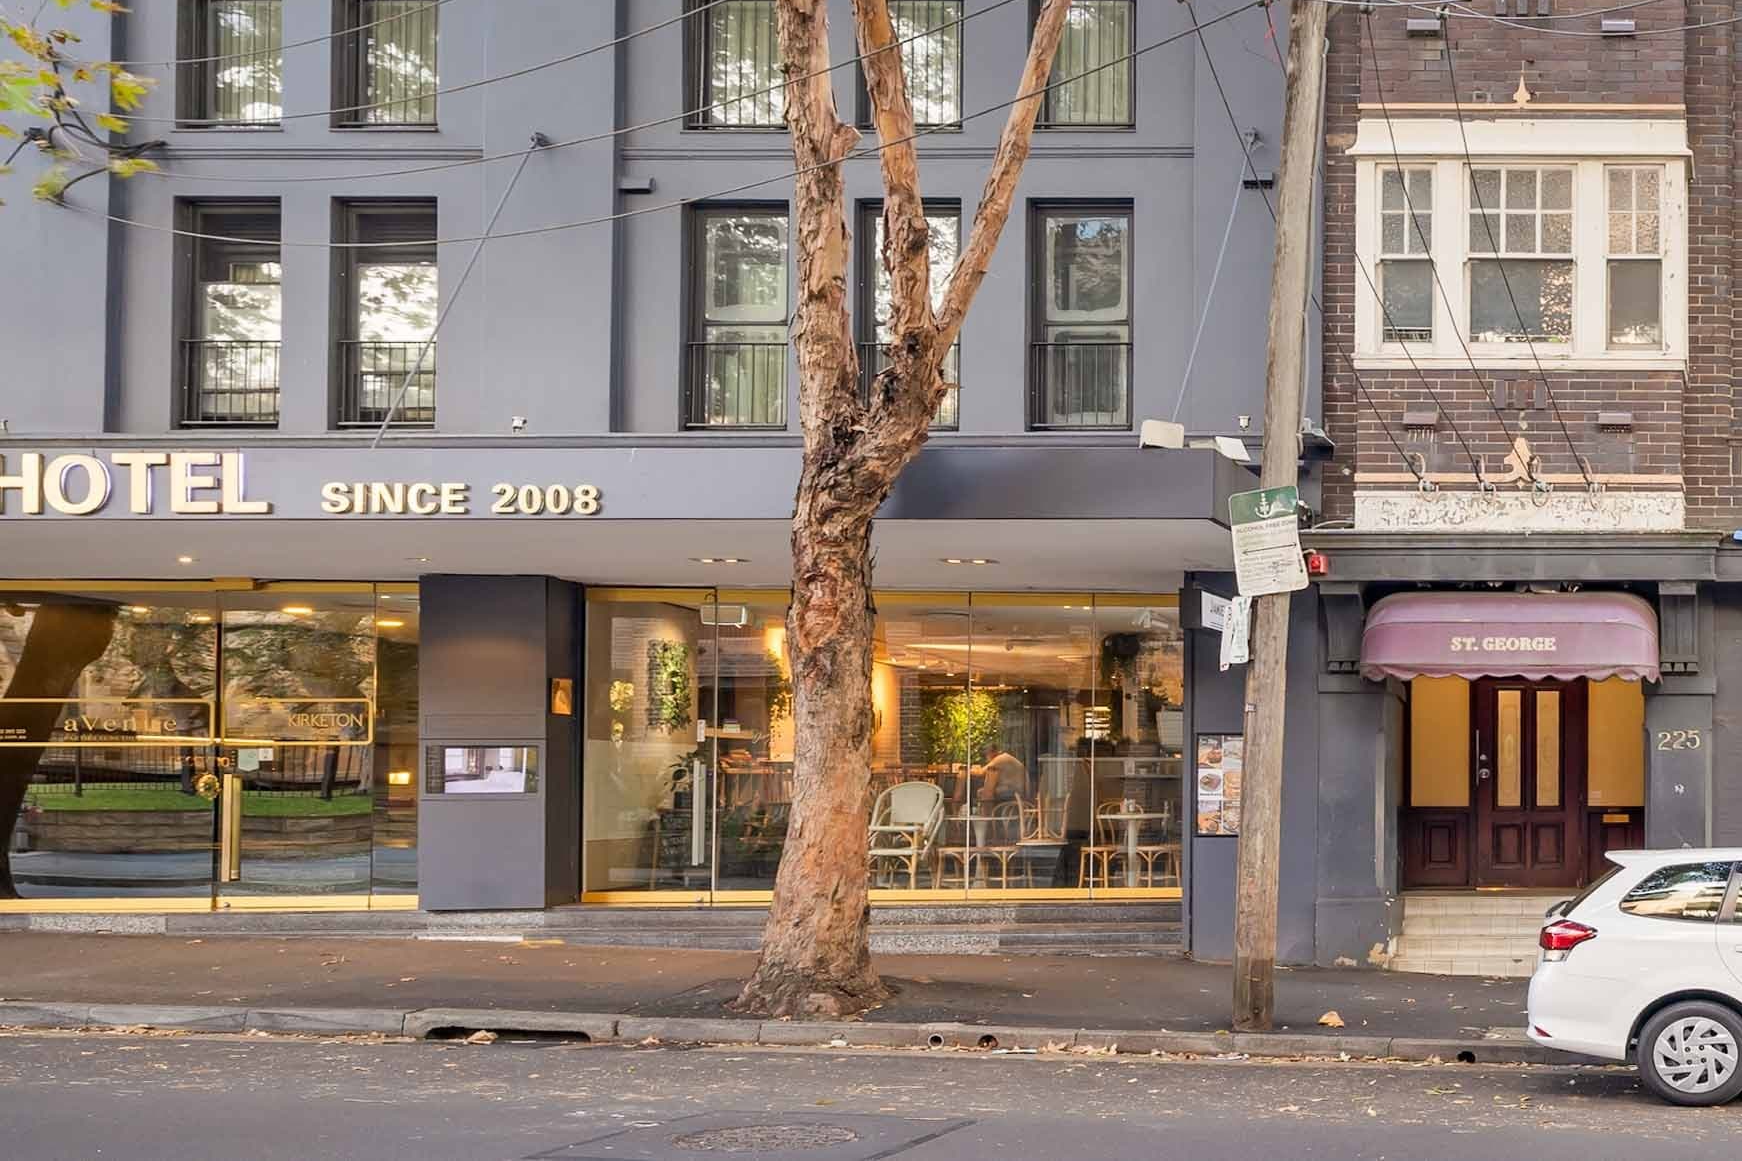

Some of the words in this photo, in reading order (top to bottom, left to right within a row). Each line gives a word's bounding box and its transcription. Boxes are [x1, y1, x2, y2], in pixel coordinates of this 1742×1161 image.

[0, 453, 272, 515] HOTEL
[320, 481, 470, 515] SINCE
[491, 483, 603, 515] 2008
[1451, 637, 1479, 652] ST.
[1483, 637, 1557, 652] GEORGE
[288, 713, 363, 727] KIRKETON
[1658, 729, 1700, 750] 225
